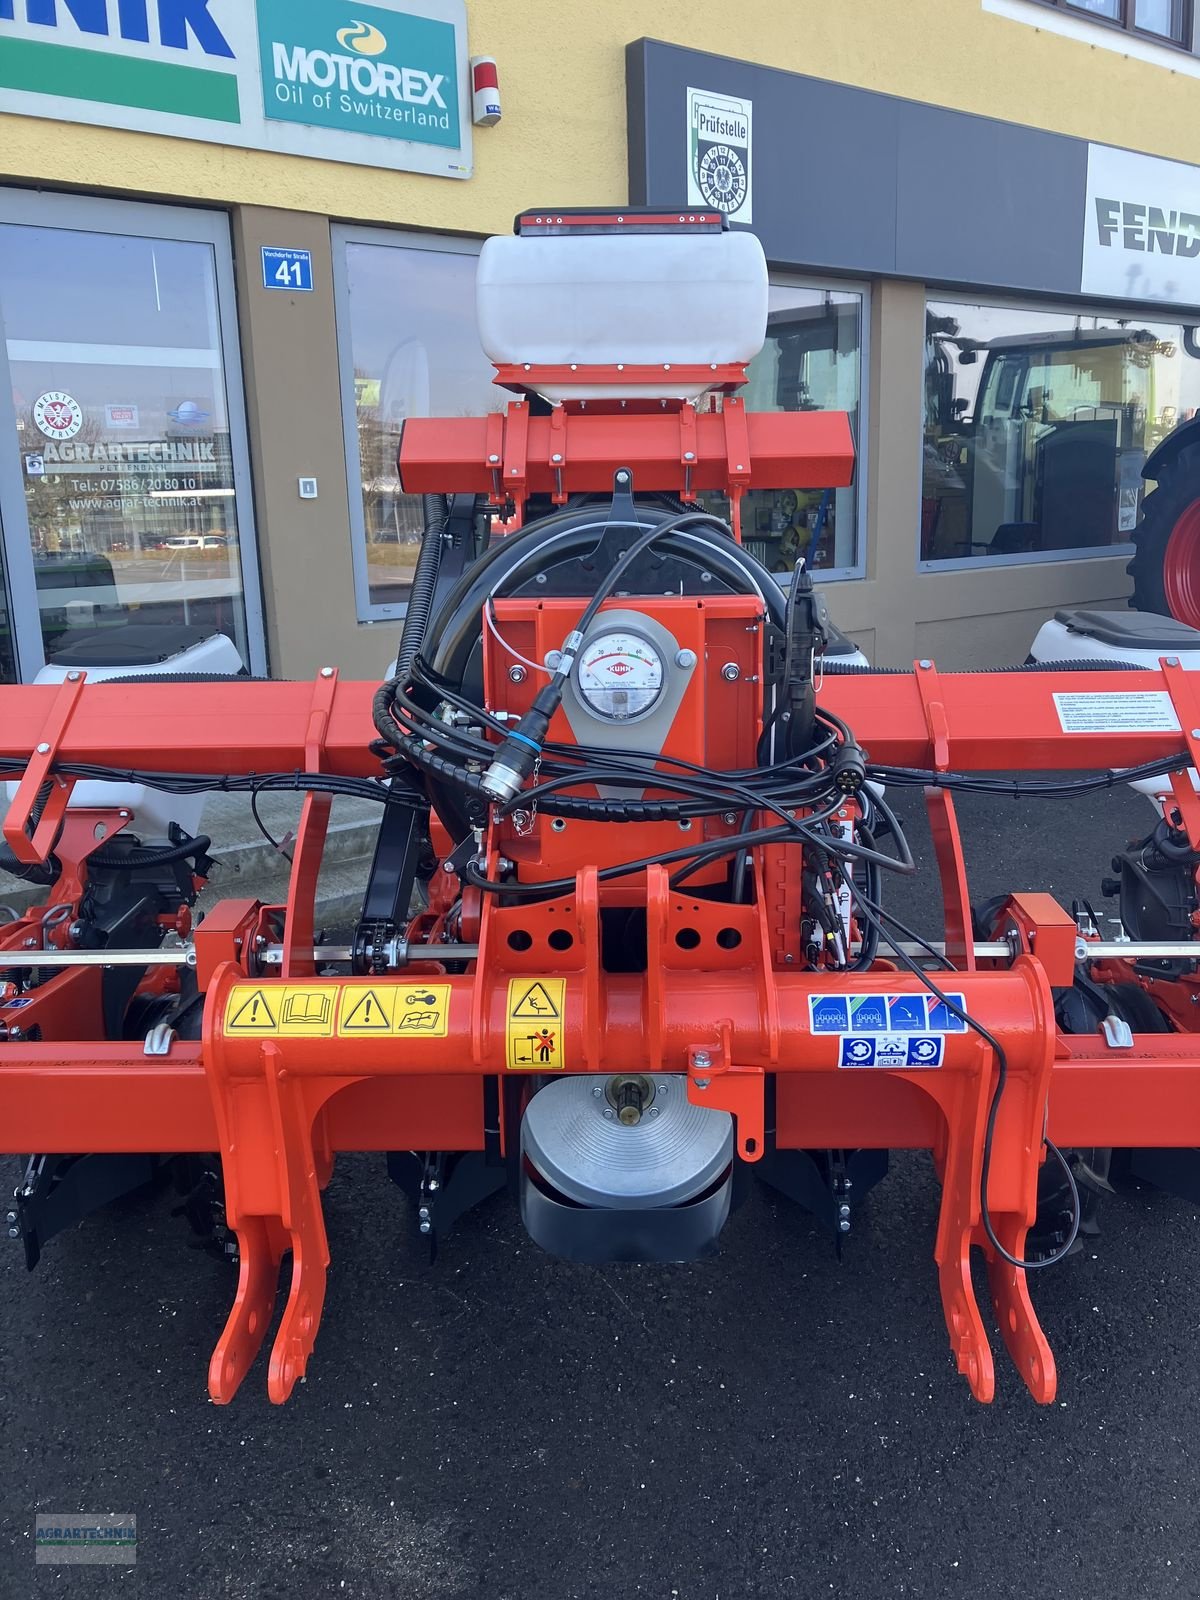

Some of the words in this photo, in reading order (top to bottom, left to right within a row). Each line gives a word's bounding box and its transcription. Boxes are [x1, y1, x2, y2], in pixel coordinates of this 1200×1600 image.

[272, 42, 447, 109] MOTOREX
[275, 83, 303, 105] Oil
[312, 91, 332, 109] of
[340, 94, 449, 129] Switzerland
[700, 113, 746, 139] Prüfstelle
[275, 260, 302, 286] 41
[37, 393, 78, 411] MEISTER
[38, 420, 80, 438] BETRIEB
[43, 442, 215, 463] AGRARTECHNIK
[71, 480, 98, 492] Tel.:
[147, 479, 161, 490] 20
[164, 478, 178, 490] 80
[182, 478, 196, 490] 10
[69, 496, 201, 511] www.agrar-technik.at
